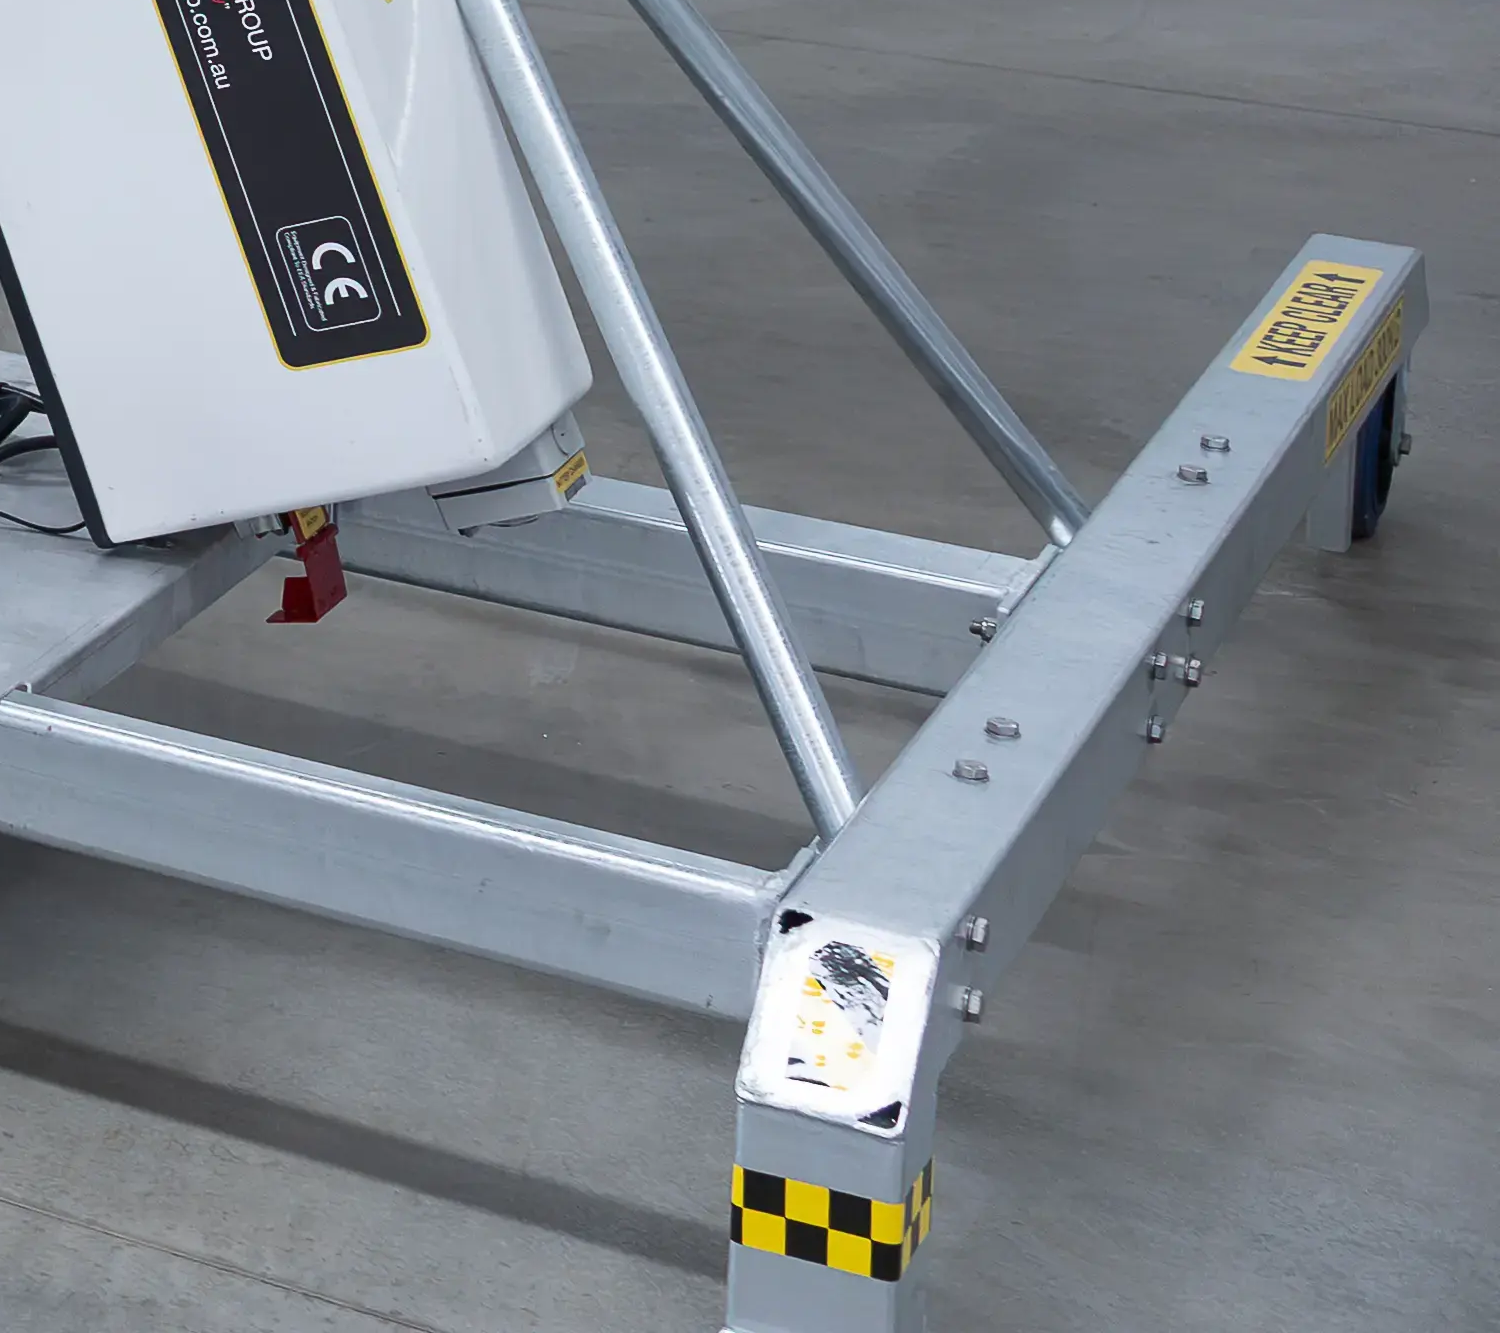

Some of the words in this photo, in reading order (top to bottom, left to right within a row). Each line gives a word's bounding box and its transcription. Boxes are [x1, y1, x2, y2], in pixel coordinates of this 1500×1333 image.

[312, 242, 368, 305] CE
[1281, 282, 1358, 323] CLEAR
[1256, 319, 1328, 358] KEEP
